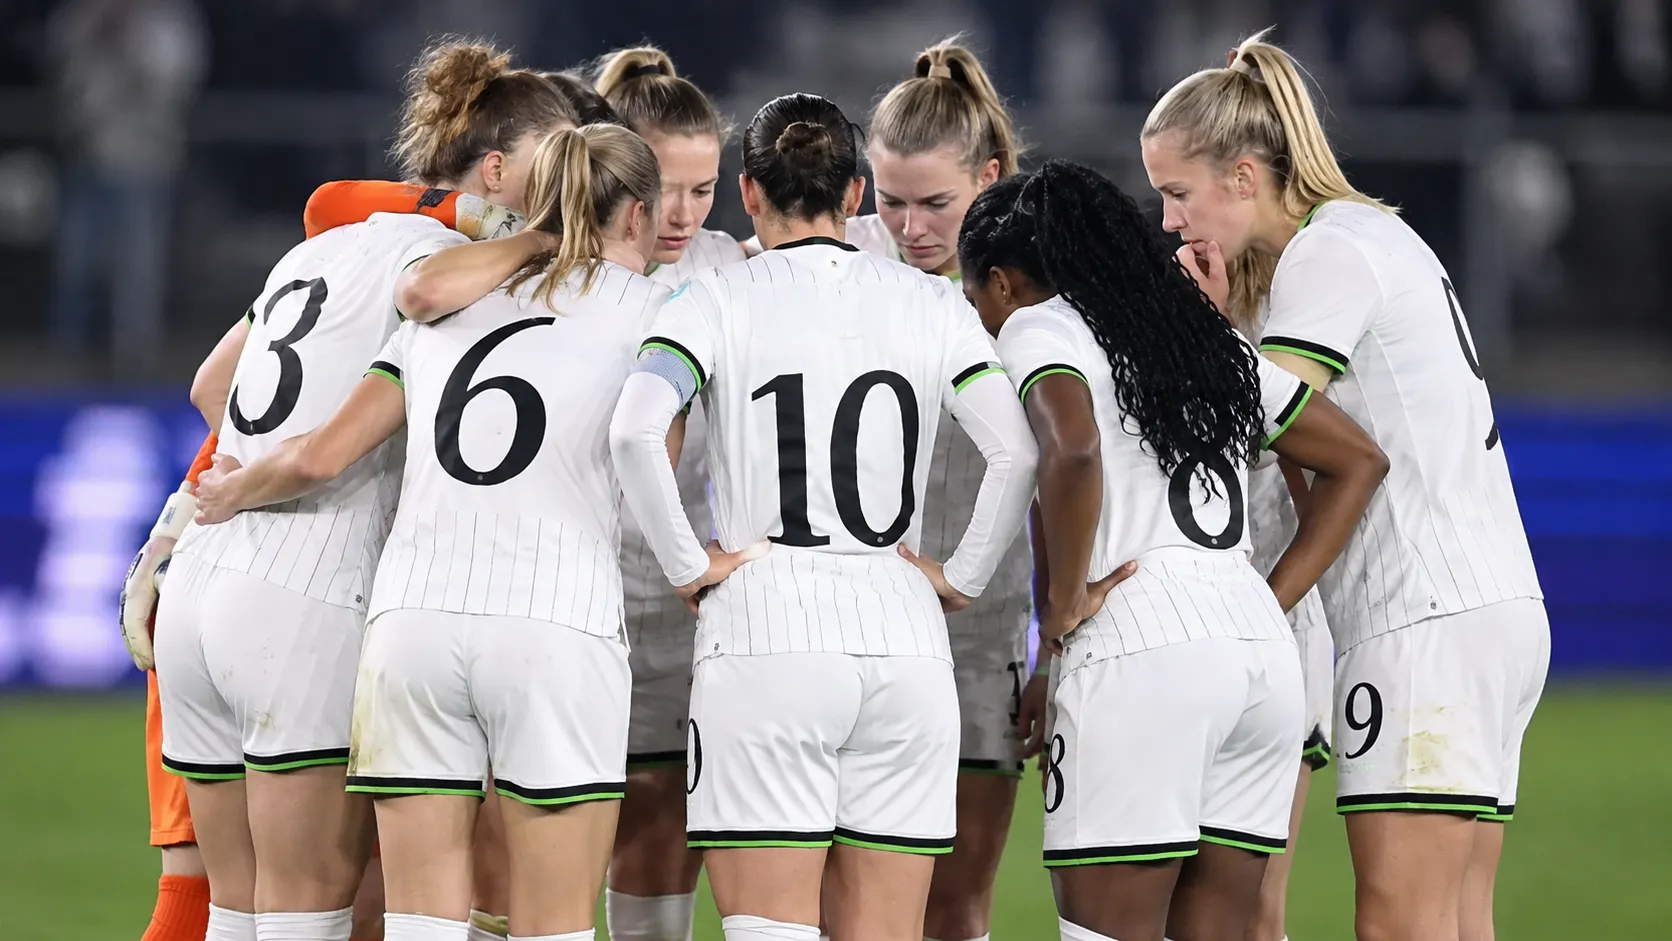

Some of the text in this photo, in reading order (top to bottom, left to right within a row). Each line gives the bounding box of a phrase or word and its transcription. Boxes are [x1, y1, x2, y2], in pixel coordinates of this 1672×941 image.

[229, 276, 328, 436] 3
[435, 317, 555, 485] 6
[752, 370, 919, 547] 10
[1045, 733, 1065, 813] 8
[1345, 682, 1382, 759] 9
